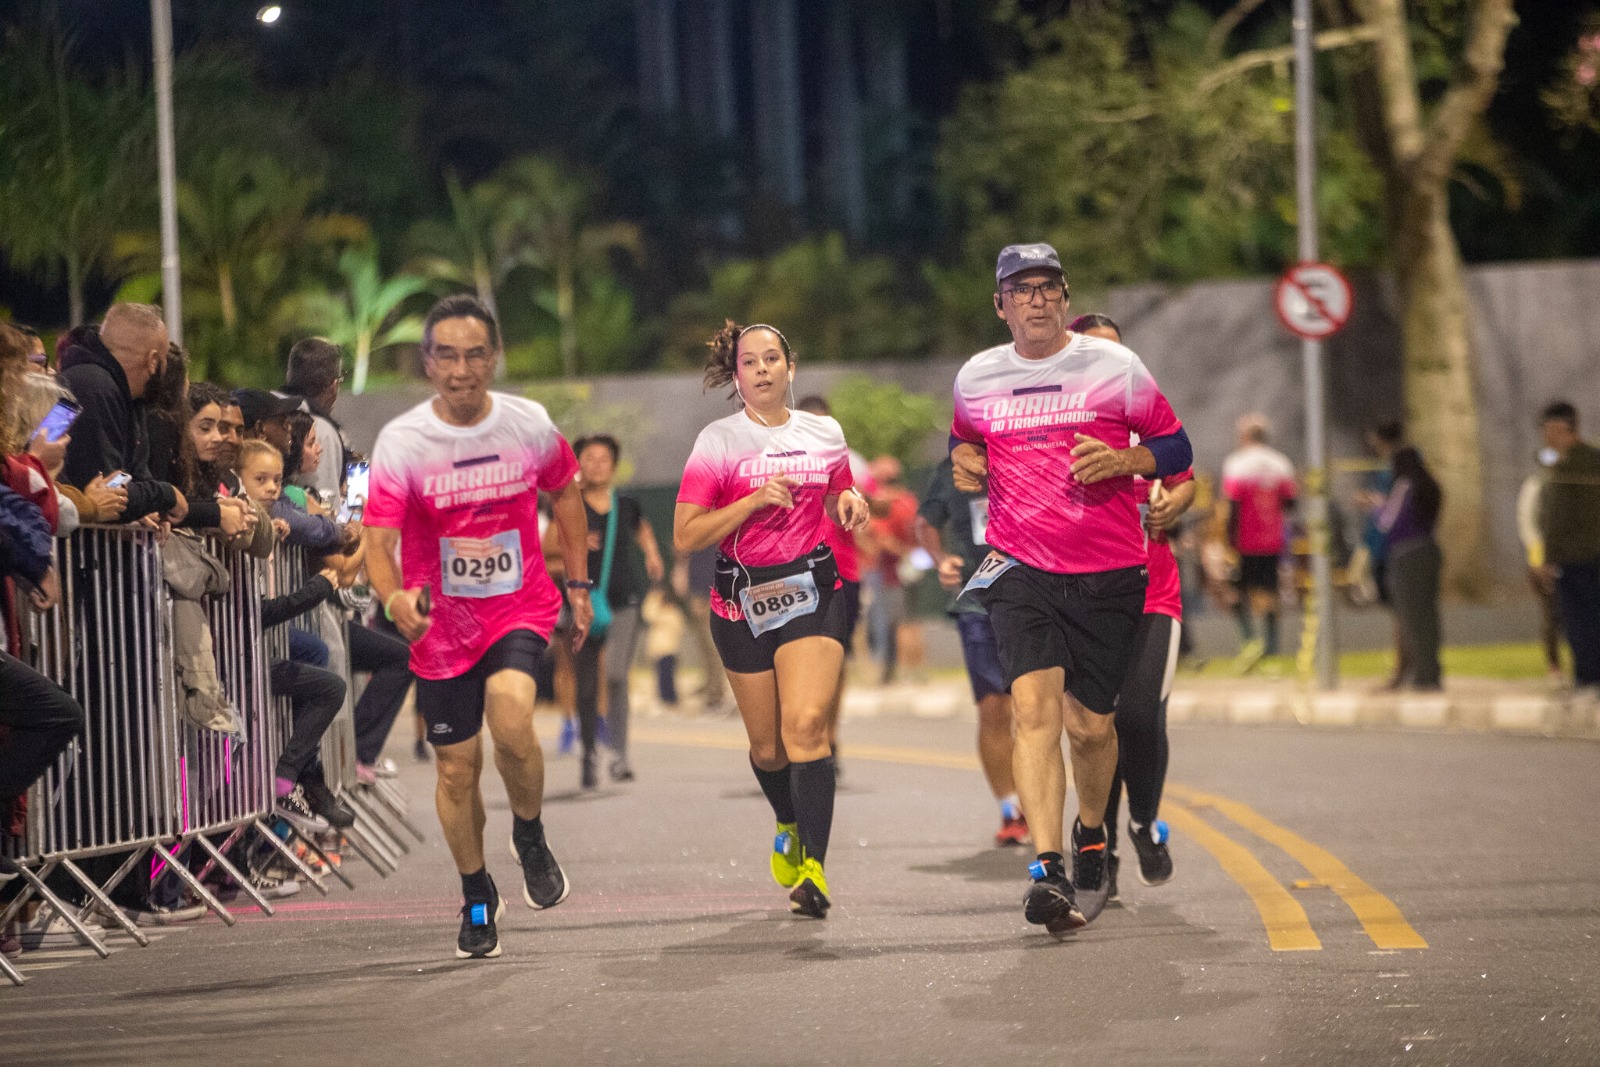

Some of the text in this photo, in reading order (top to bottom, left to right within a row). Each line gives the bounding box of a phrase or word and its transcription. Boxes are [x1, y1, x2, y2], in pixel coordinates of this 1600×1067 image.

[982, 392, 1088, 421] CORRIDA
[990, 420, 1006, 433] DO
[1008, 410, 1098, 430] TRABALHADOR
[1012, 440, 1068, 453] EM GUARAREMA
[423, 462, 523, 497] CORRIDA
[739, 457, 827, 478] CORRIDA
[750, 477, 765, 489] DO
[452, 552, 512, 578] 0290
[752, 591, 809, 616] 0803
